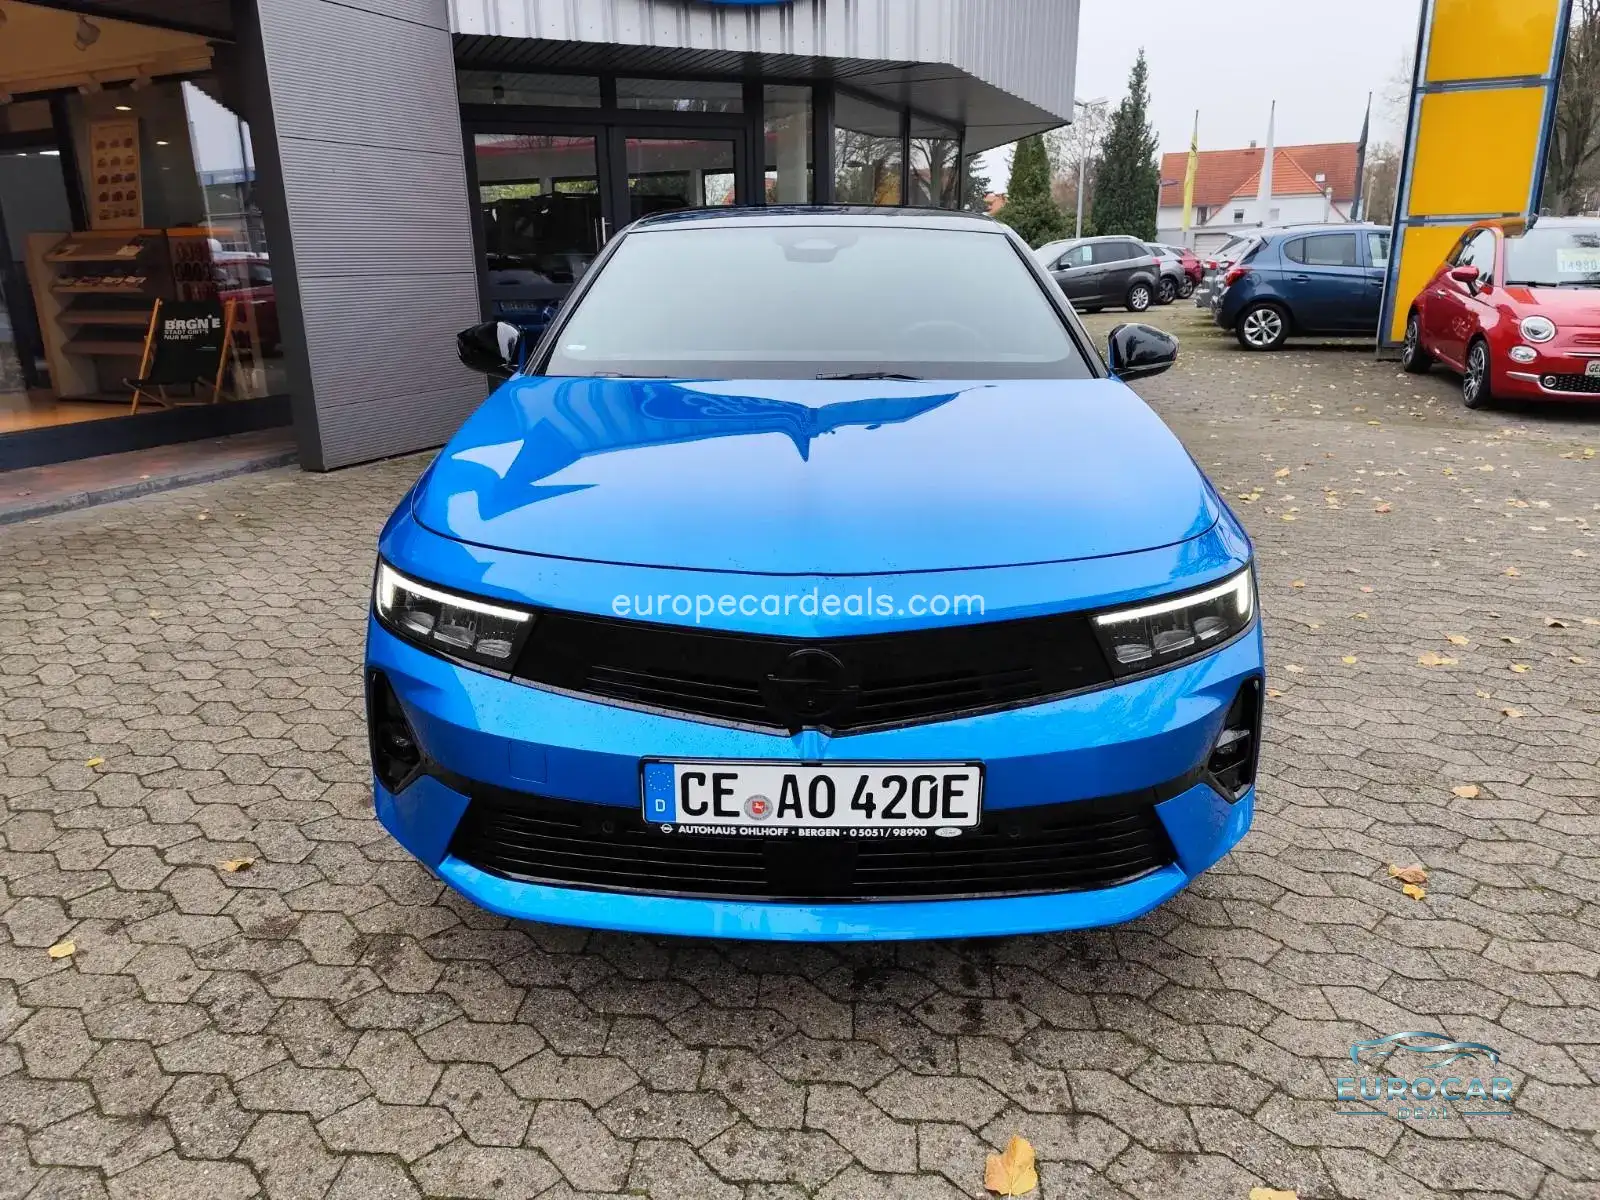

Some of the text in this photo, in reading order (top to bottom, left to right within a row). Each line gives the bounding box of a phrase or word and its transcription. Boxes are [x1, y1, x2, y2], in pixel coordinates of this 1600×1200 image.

[680, 771, 740, 817] CE
[776, 774, 836, 819] AO
[850, 774, 969, 820] 420E
[655, 799, 666, 813] D
[678, 825, 737, 835] AUTOHAUS
[739, 827, 789, 836] OHLHOFF
[798, 828, 840, 837] BERGEN
